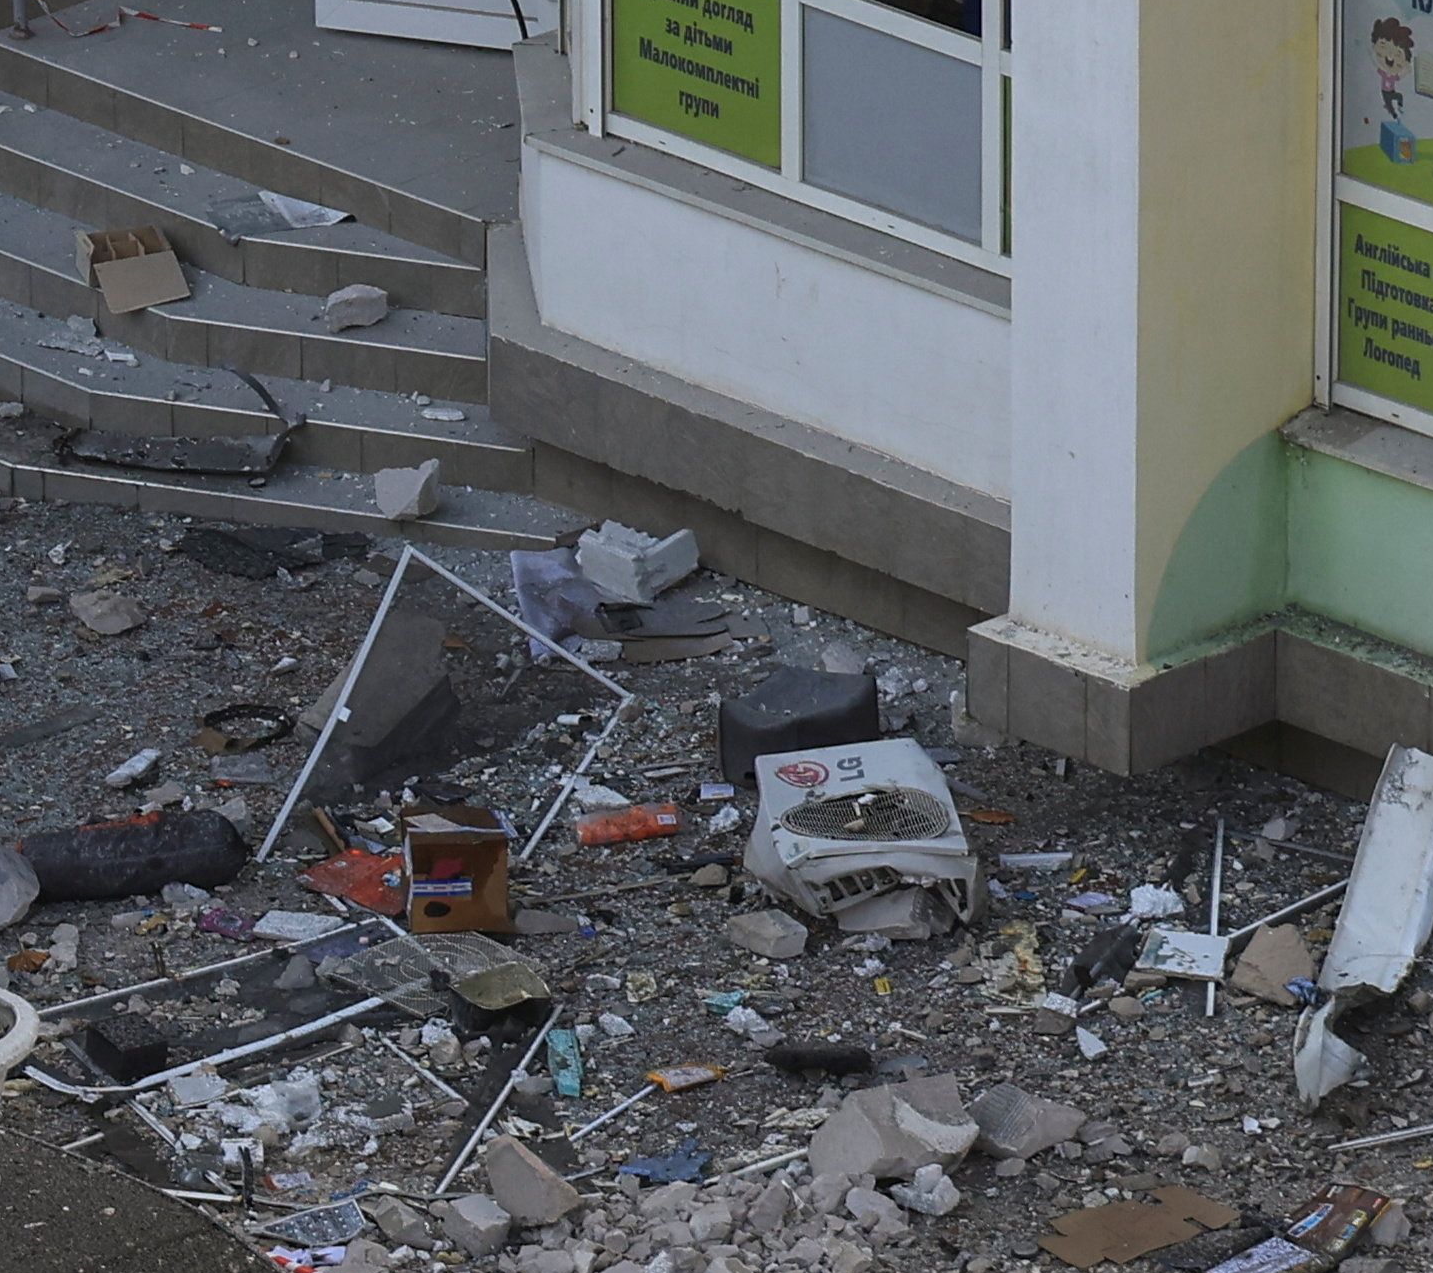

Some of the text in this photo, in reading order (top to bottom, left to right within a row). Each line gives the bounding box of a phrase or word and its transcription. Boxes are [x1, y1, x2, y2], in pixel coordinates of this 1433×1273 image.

[665, 17, 732, 56] за дітьми
[639, 36, 759, 99] Малокомплектні
[679, 90, 719, 119] групи
[1354, 234, 1430, 278] Англійська
[1348, 297, 1388, 331] Групи
[1363, 338, 1421, 380] Логопед
[837, 756, 864, 782] LG
